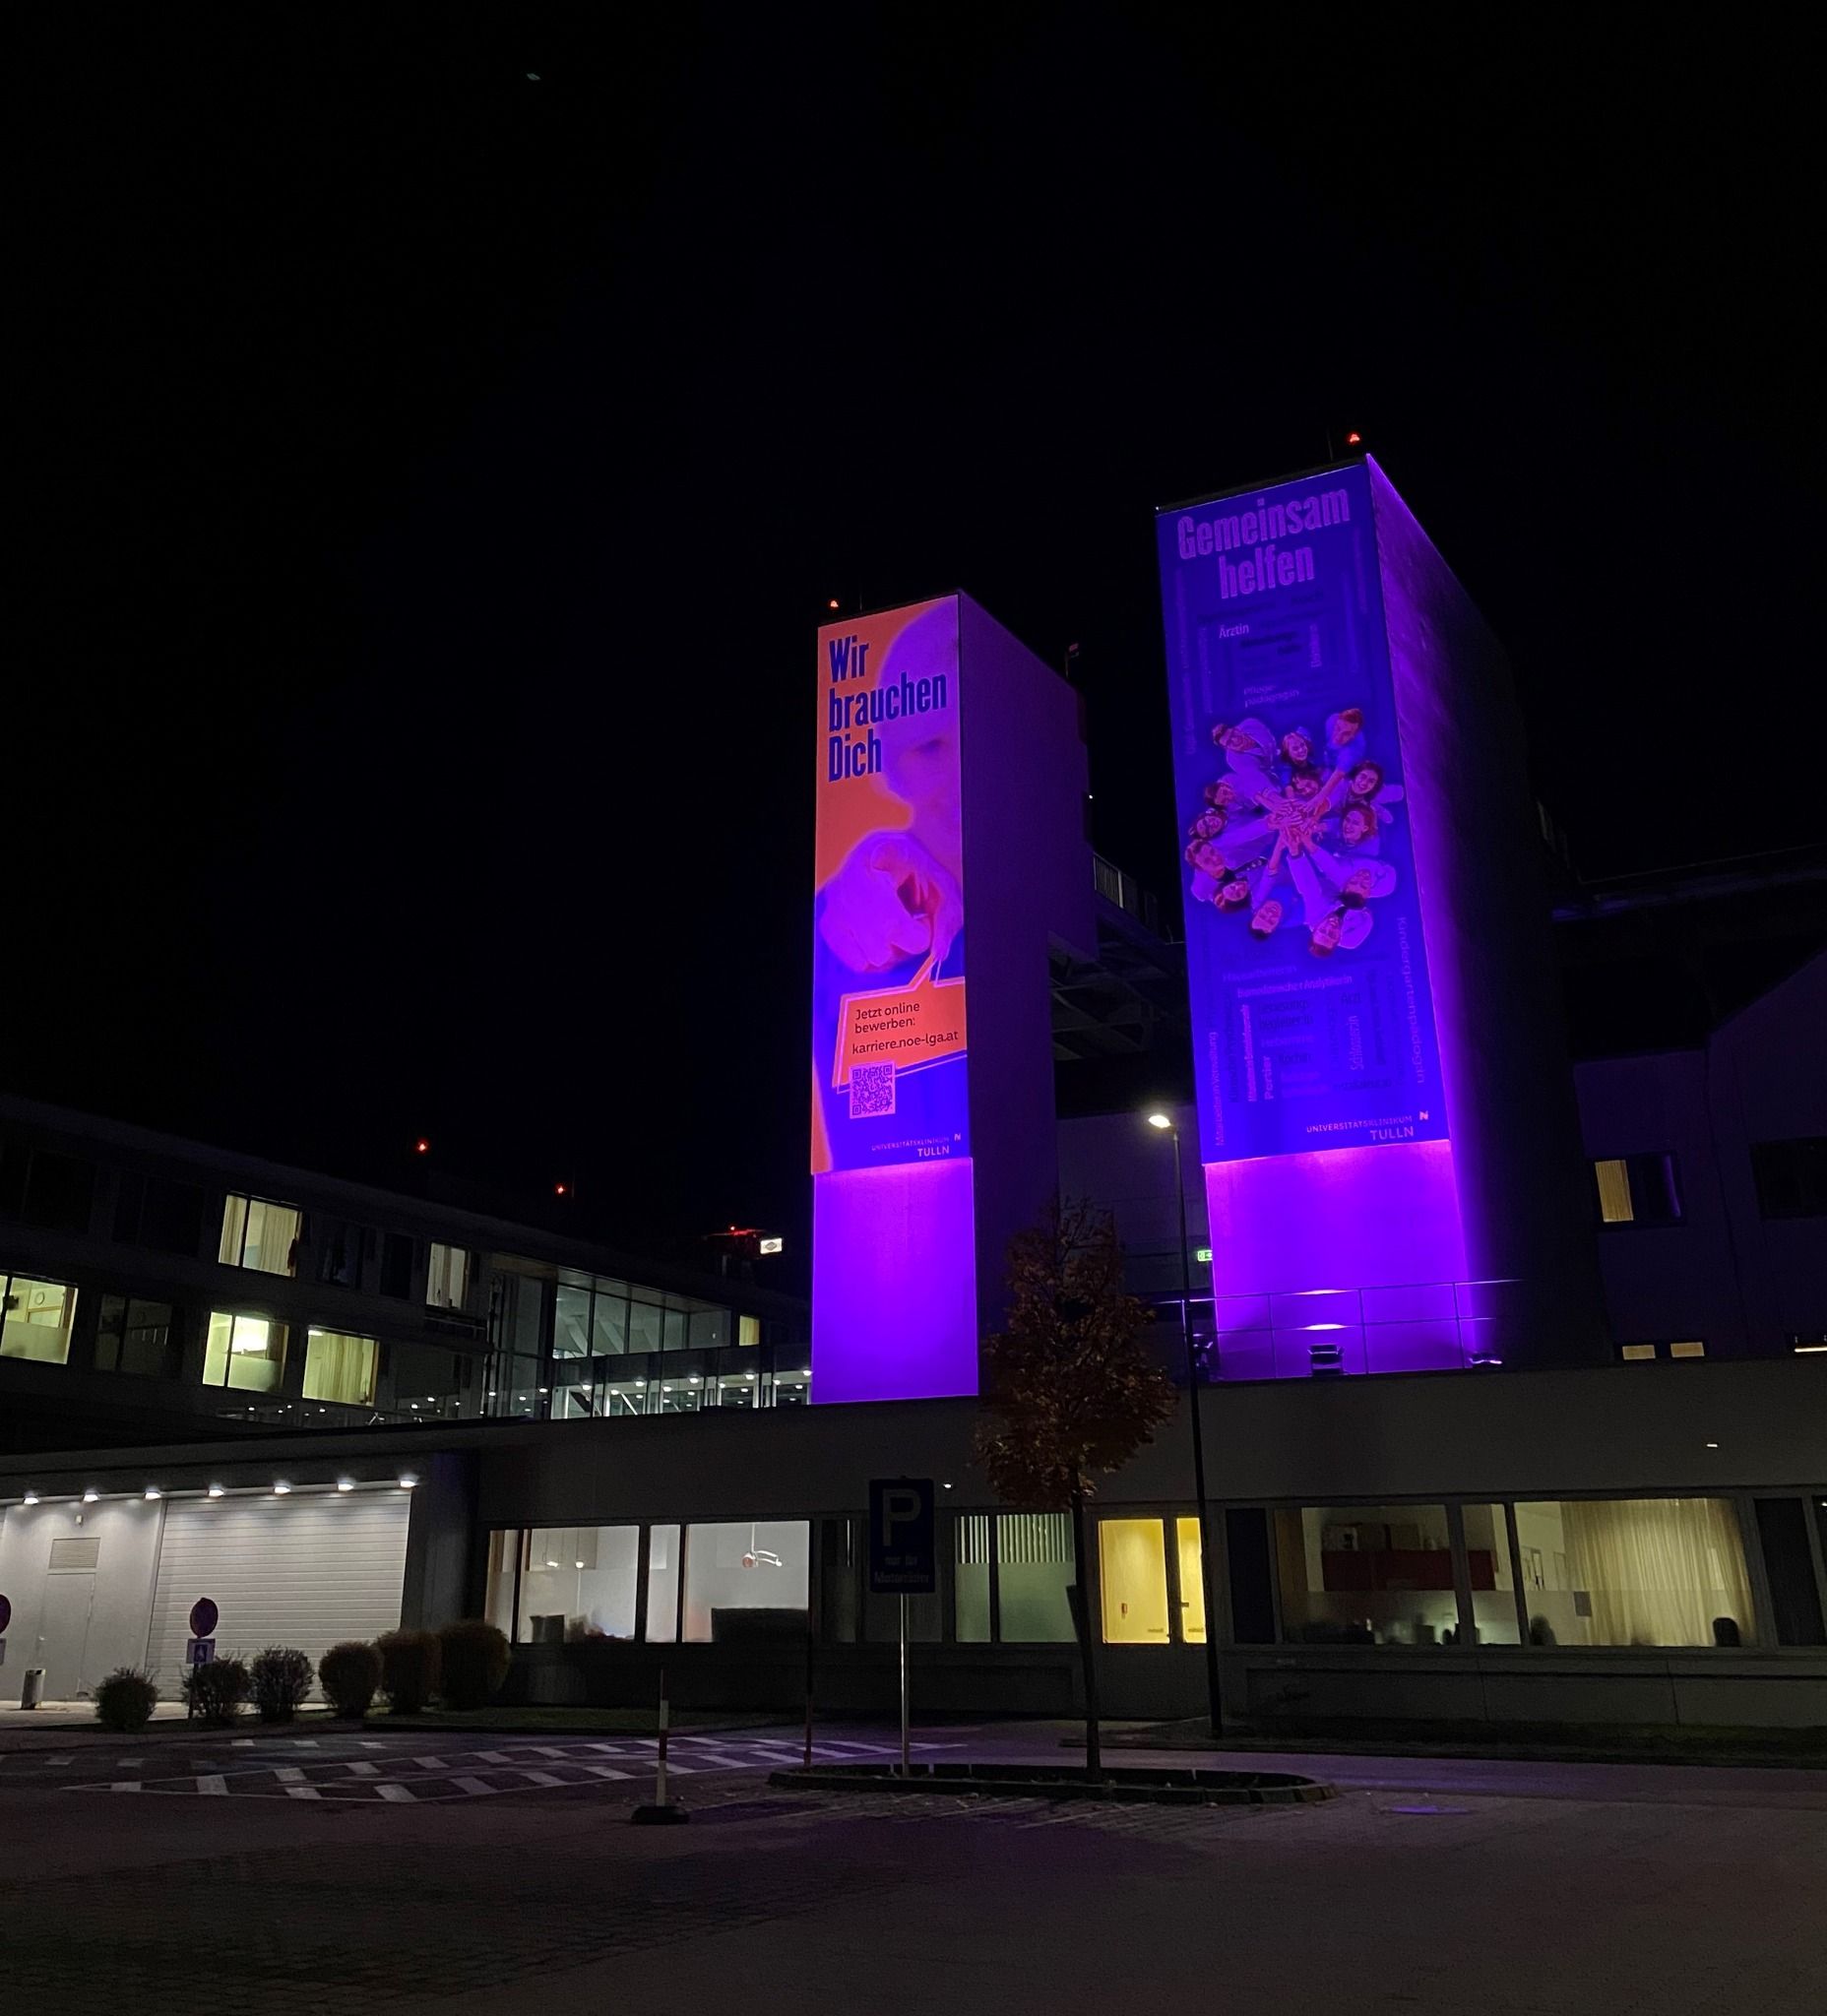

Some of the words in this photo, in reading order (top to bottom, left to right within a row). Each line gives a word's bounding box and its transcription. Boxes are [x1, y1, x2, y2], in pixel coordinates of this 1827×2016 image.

[1177, 488, 1351, 559] Gemeinsam
[1219, 544, 1315, 599] helfen
[829, 635, 869, 683] Wir
[829, 671, 947, 732] brauchen
[829, 728, 882, 782] Dich
[854, 1008, 882, 1021] Jetzt
[884, 1001, 920, 1016] online
[854, 1017, 915, 1034] bewerben:
[852, 1031, 959, 1054] karriere.noe-lga.at
[917, 1145, 950, 1157] TULLN
[1370, 1125, 1414, 1141] TULLN
[882, 1487, 921, 1546] P
